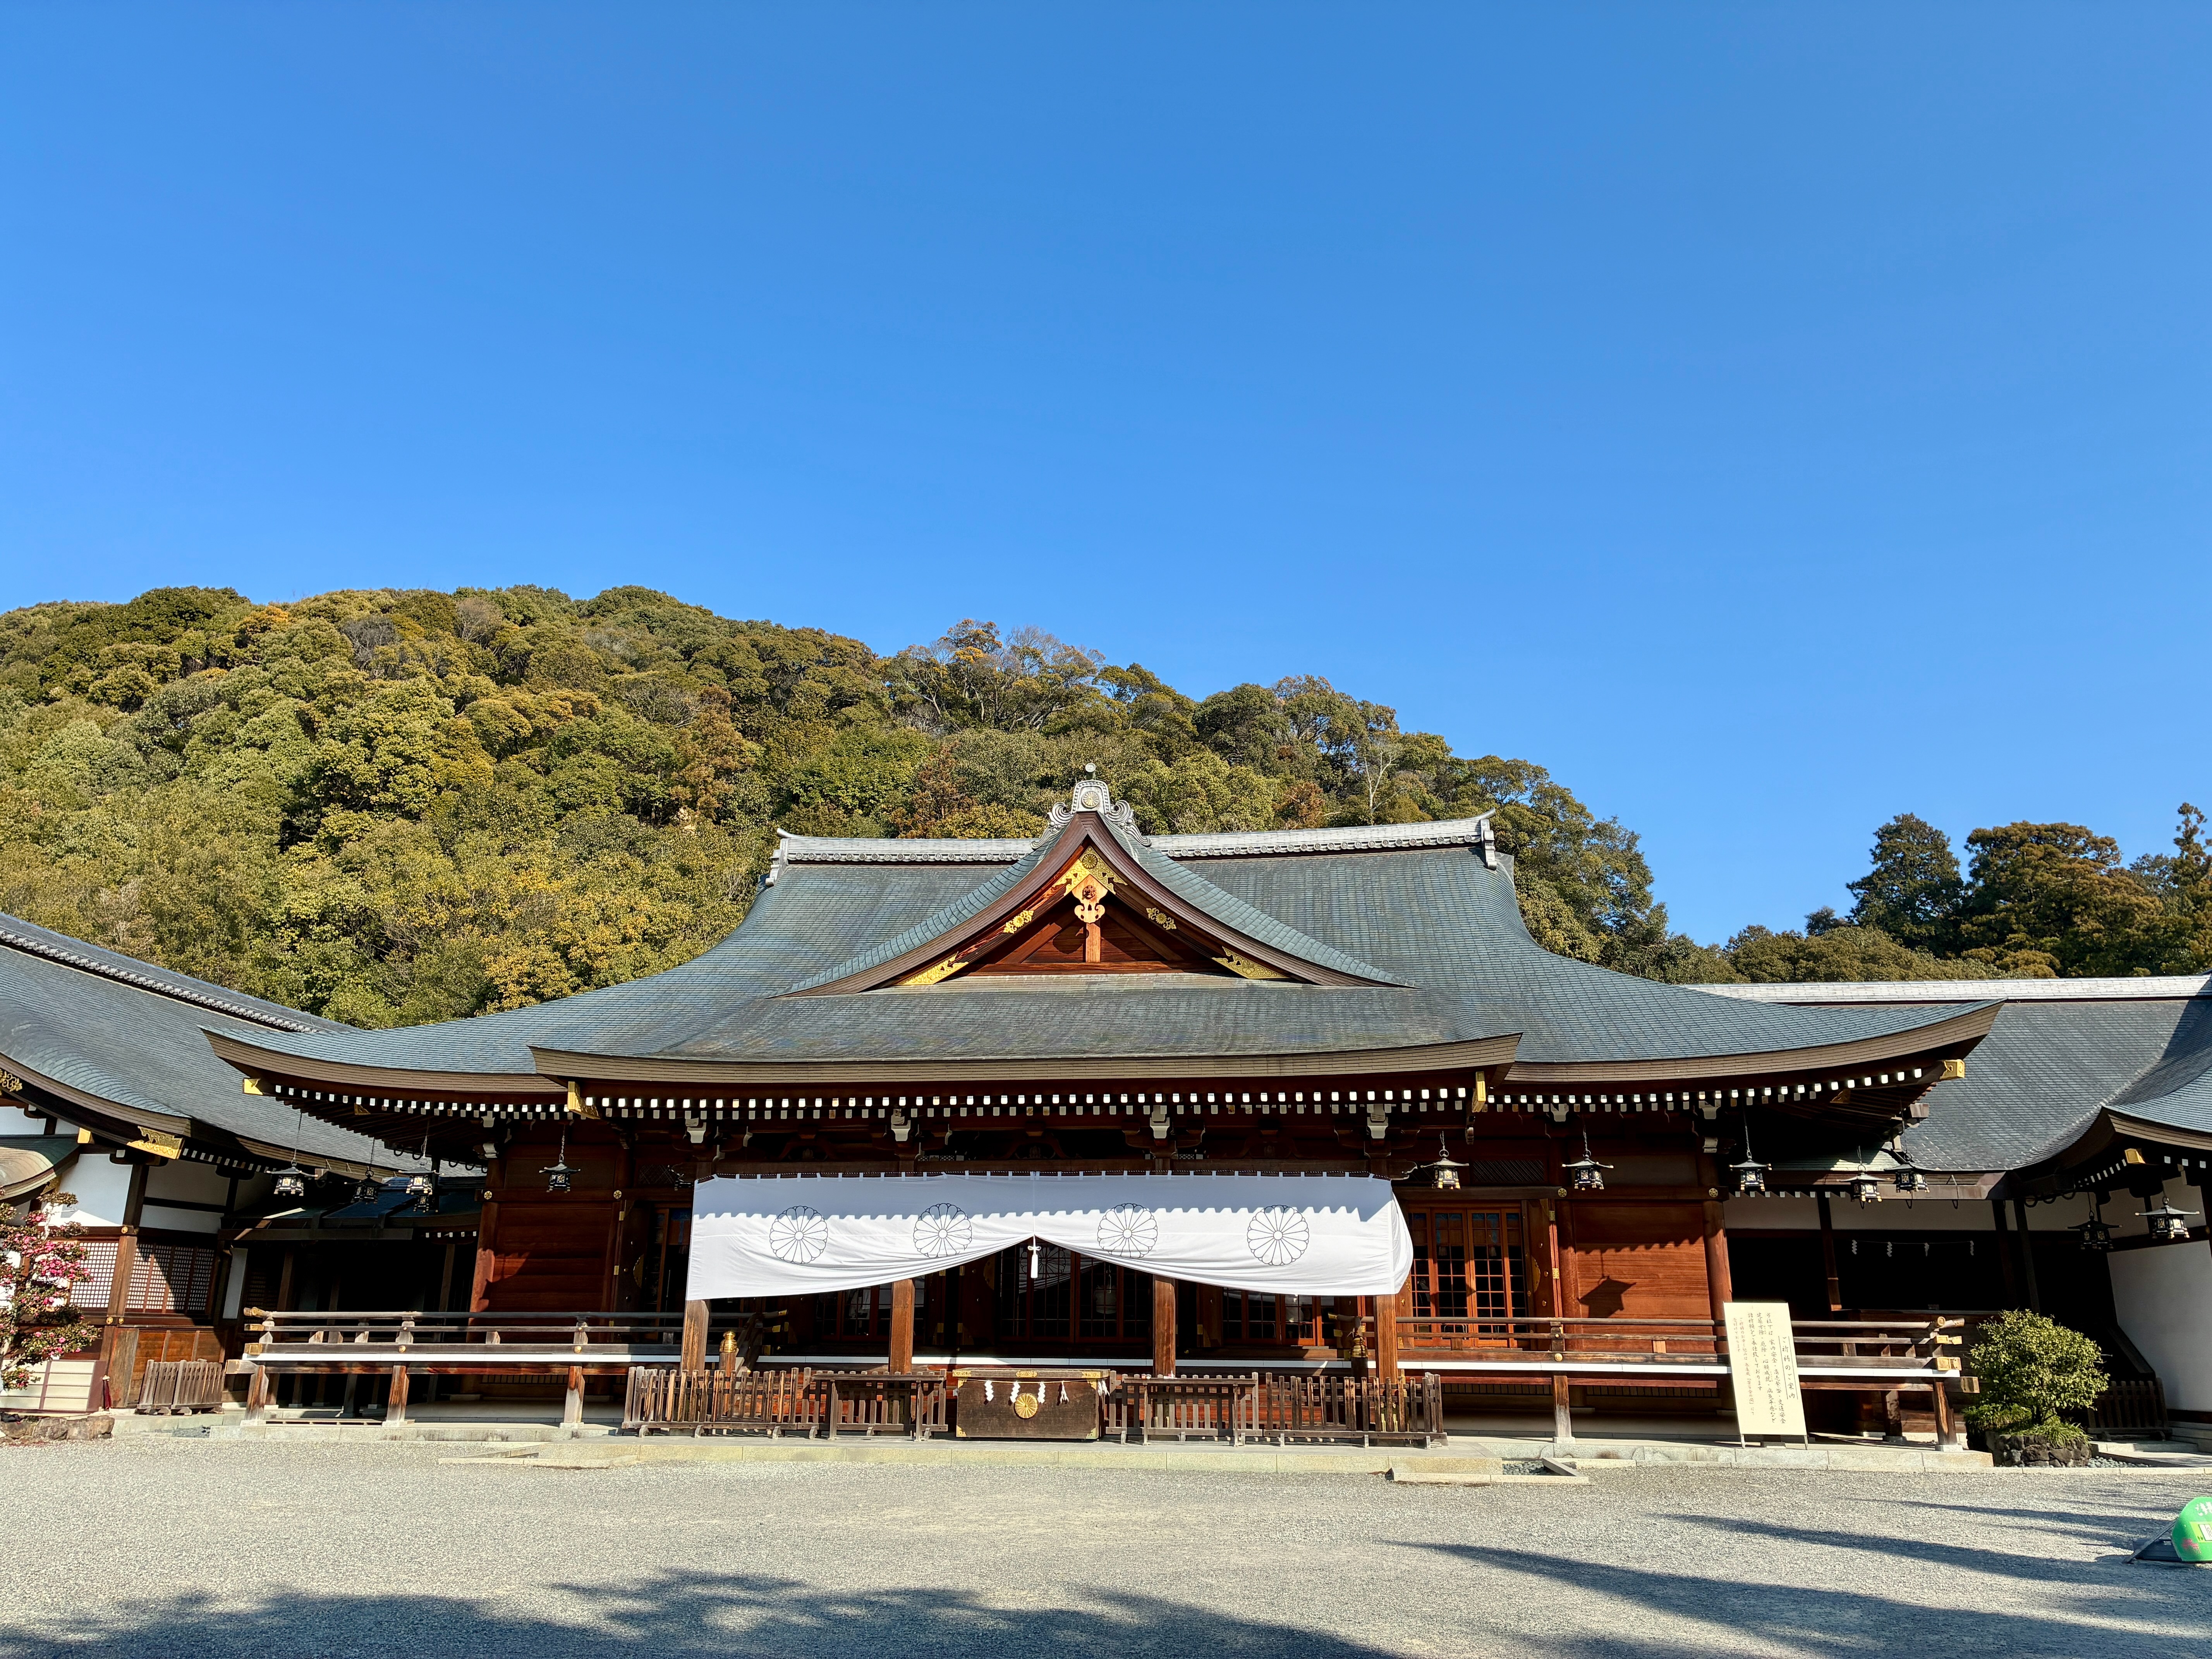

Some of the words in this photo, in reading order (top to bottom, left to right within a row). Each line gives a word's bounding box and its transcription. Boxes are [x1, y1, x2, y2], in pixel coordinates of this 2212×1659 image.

[1783, 1337, 1795, 1399] ご祈祷のご案内
